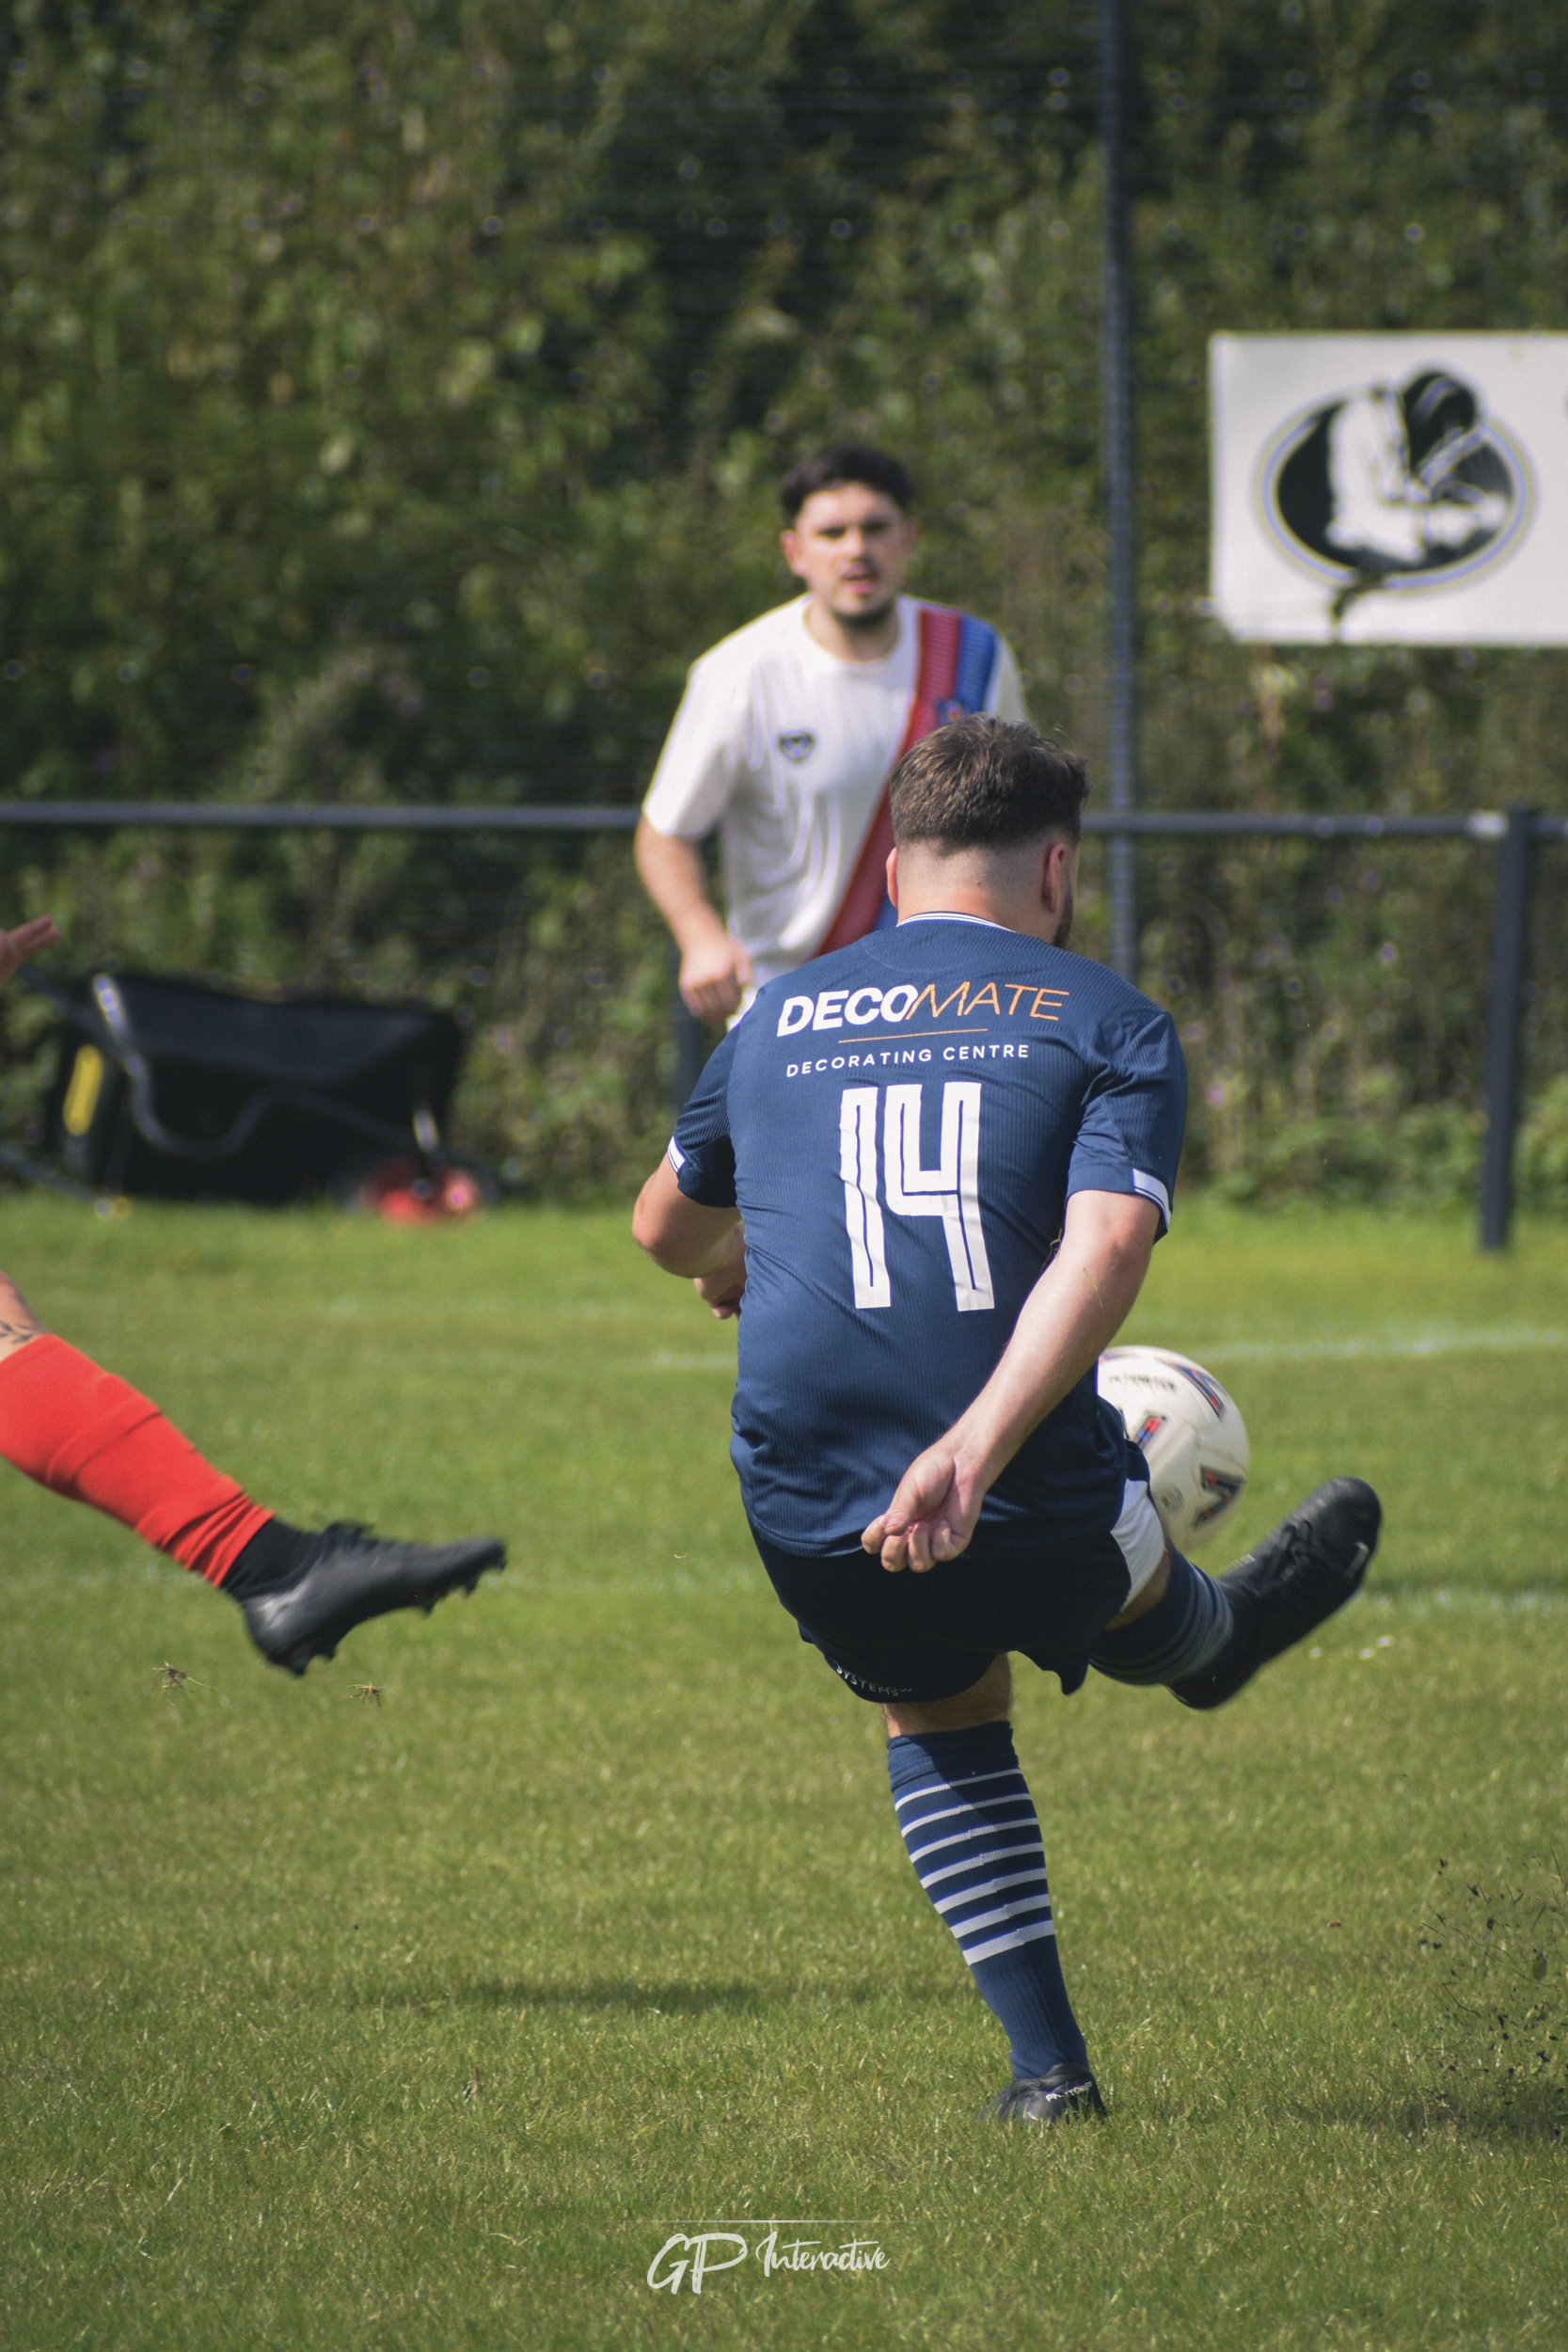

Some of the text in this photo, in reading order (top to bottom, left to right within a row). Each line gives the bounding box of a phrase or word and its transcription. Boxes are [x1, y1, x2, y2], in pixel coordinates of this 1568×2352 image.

[777, 981, 1069, 1038] DECOMATE
[786, 1044, 1029, 1078] DECORATING CENTRE
[840, 1081, 995, 1311] 14
